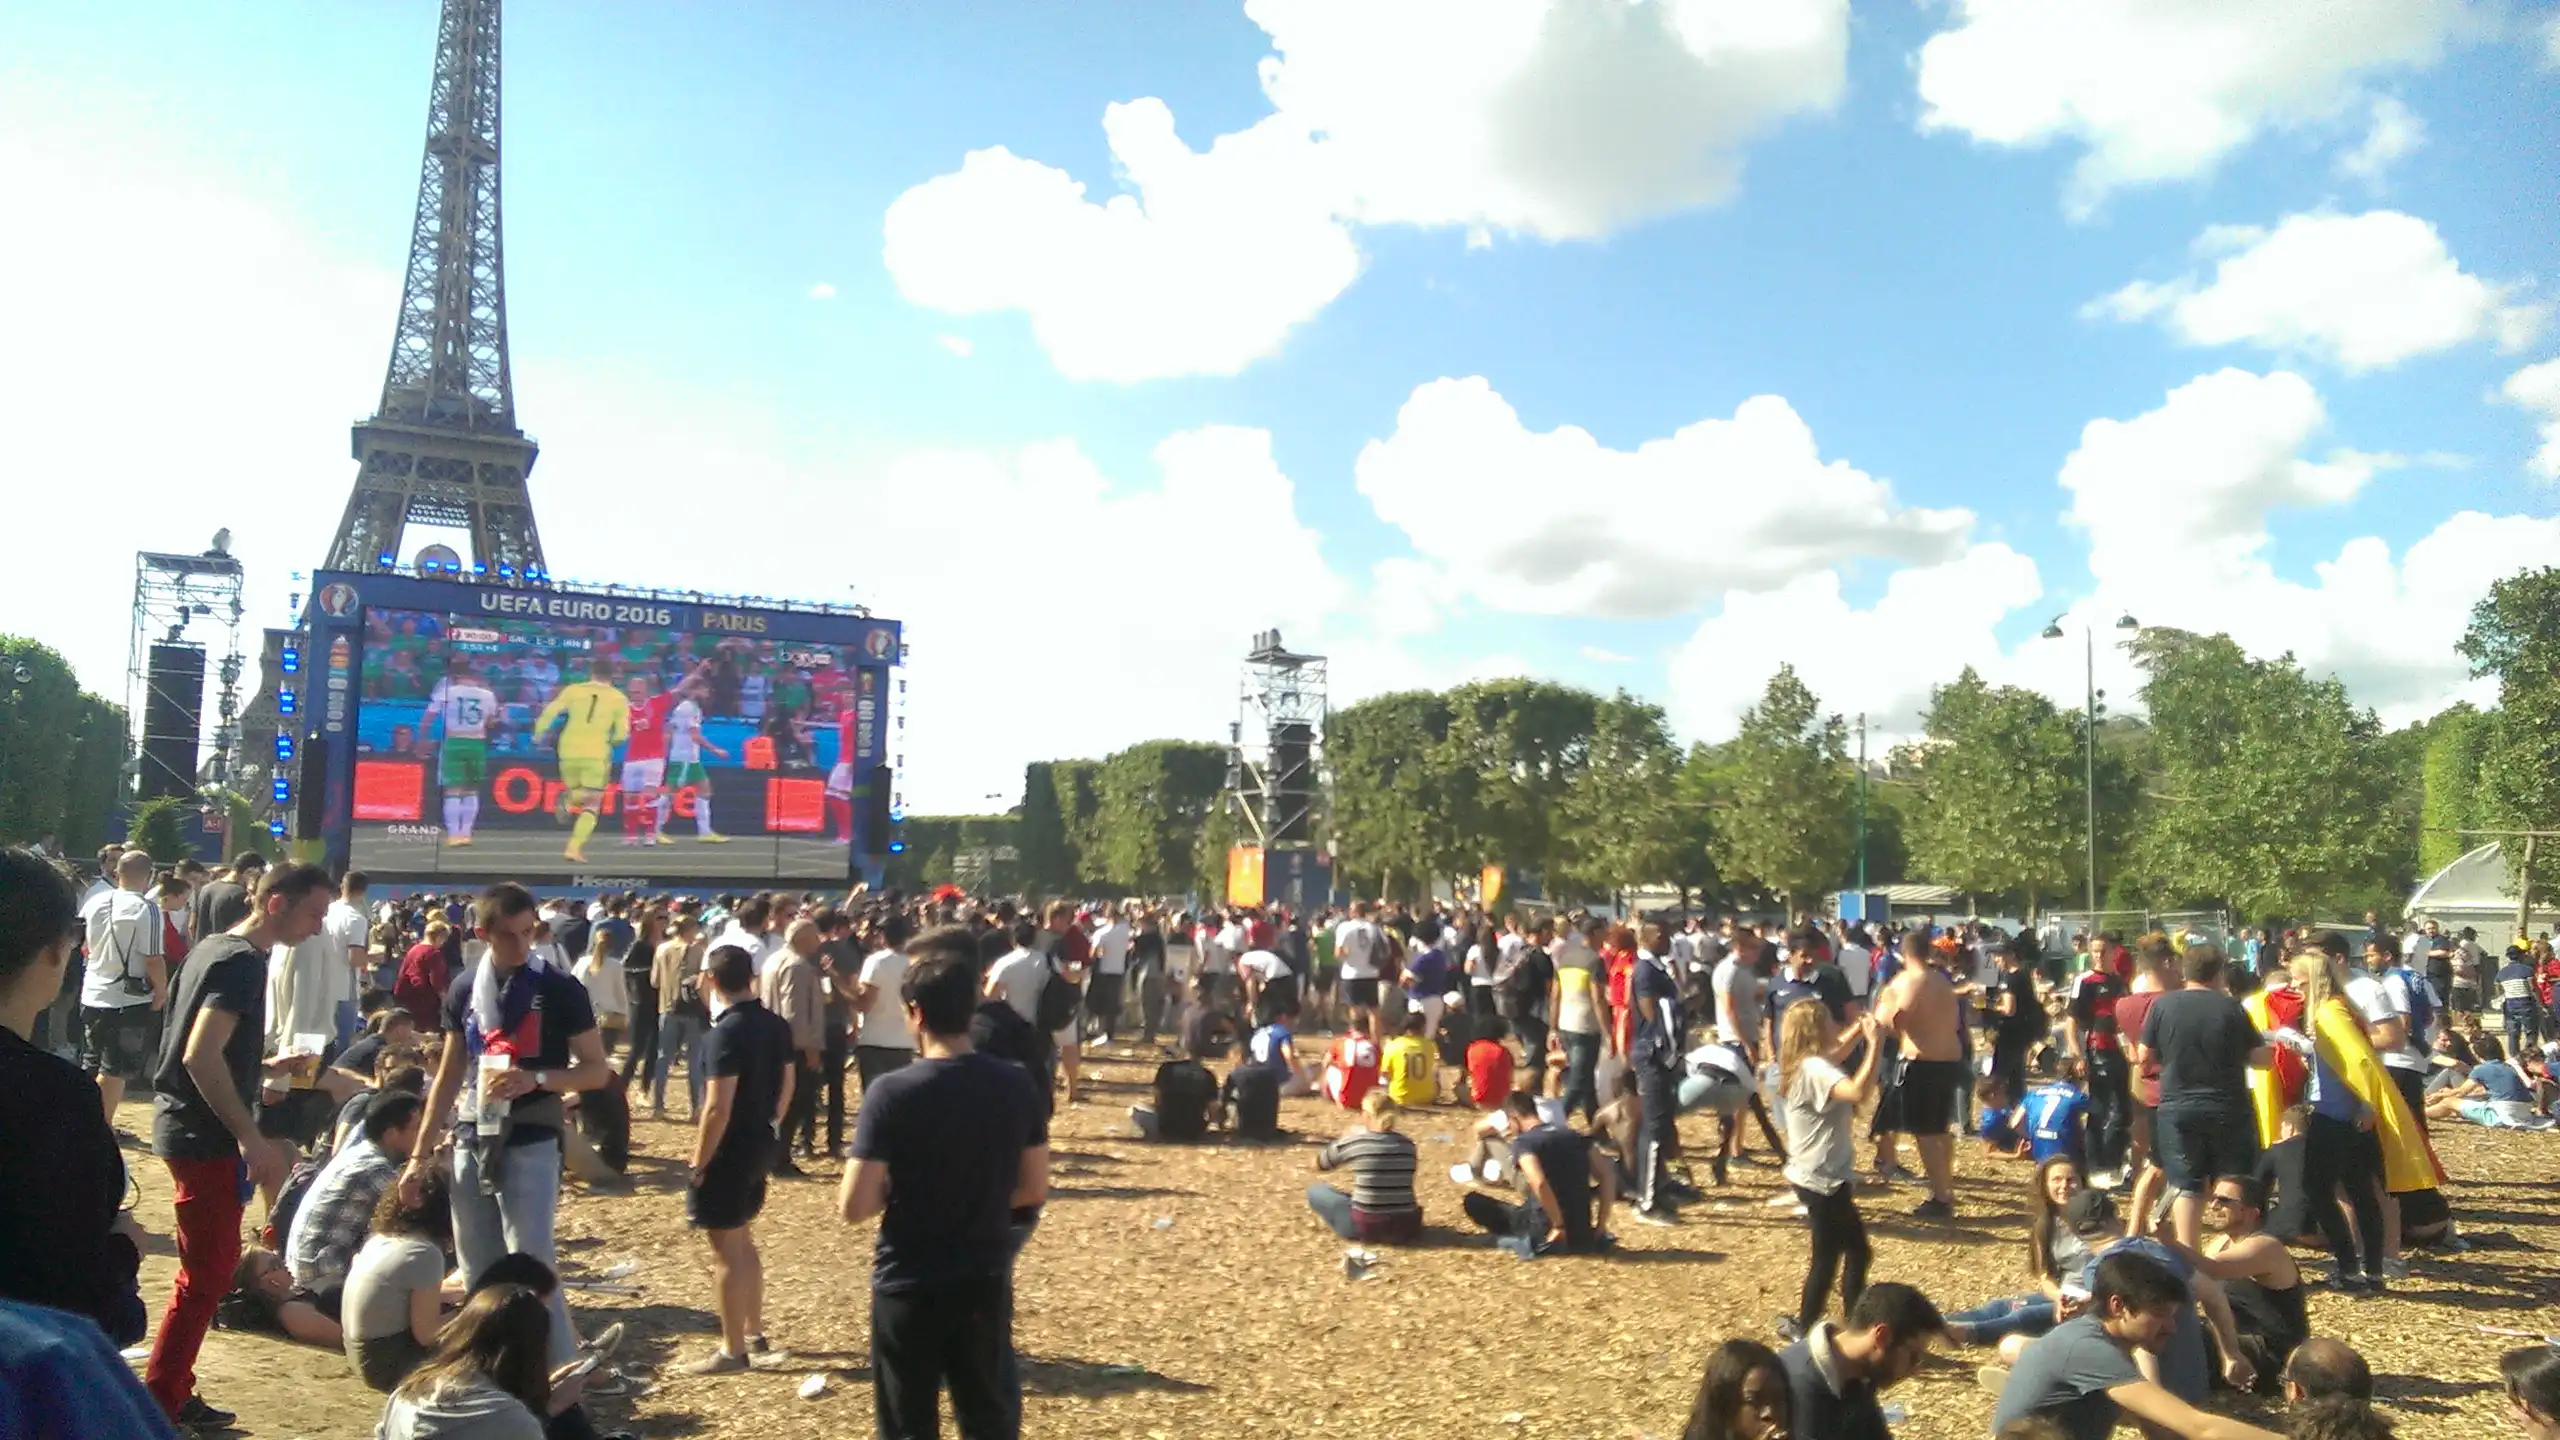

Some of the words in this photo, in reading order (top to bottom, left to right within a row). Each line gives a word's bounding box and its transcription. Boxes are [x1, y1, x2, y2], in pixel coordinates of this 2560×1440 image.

[480, 592, 544, 615] UEFA
[547, 599, 612, 621] EURO
[615, 605, 672, 626] 2016
[702, 611, 768, 633] PARIS
[457, 696, 482, 725] 13
[586, 694, 598, 724] 1
[387, 823, 442, 835] GRAND
[573, 874, 649, 889] Hisense
[1403, 1052, 1427, 1081] 10
[2039, 1094, 2062, 1129] 7
